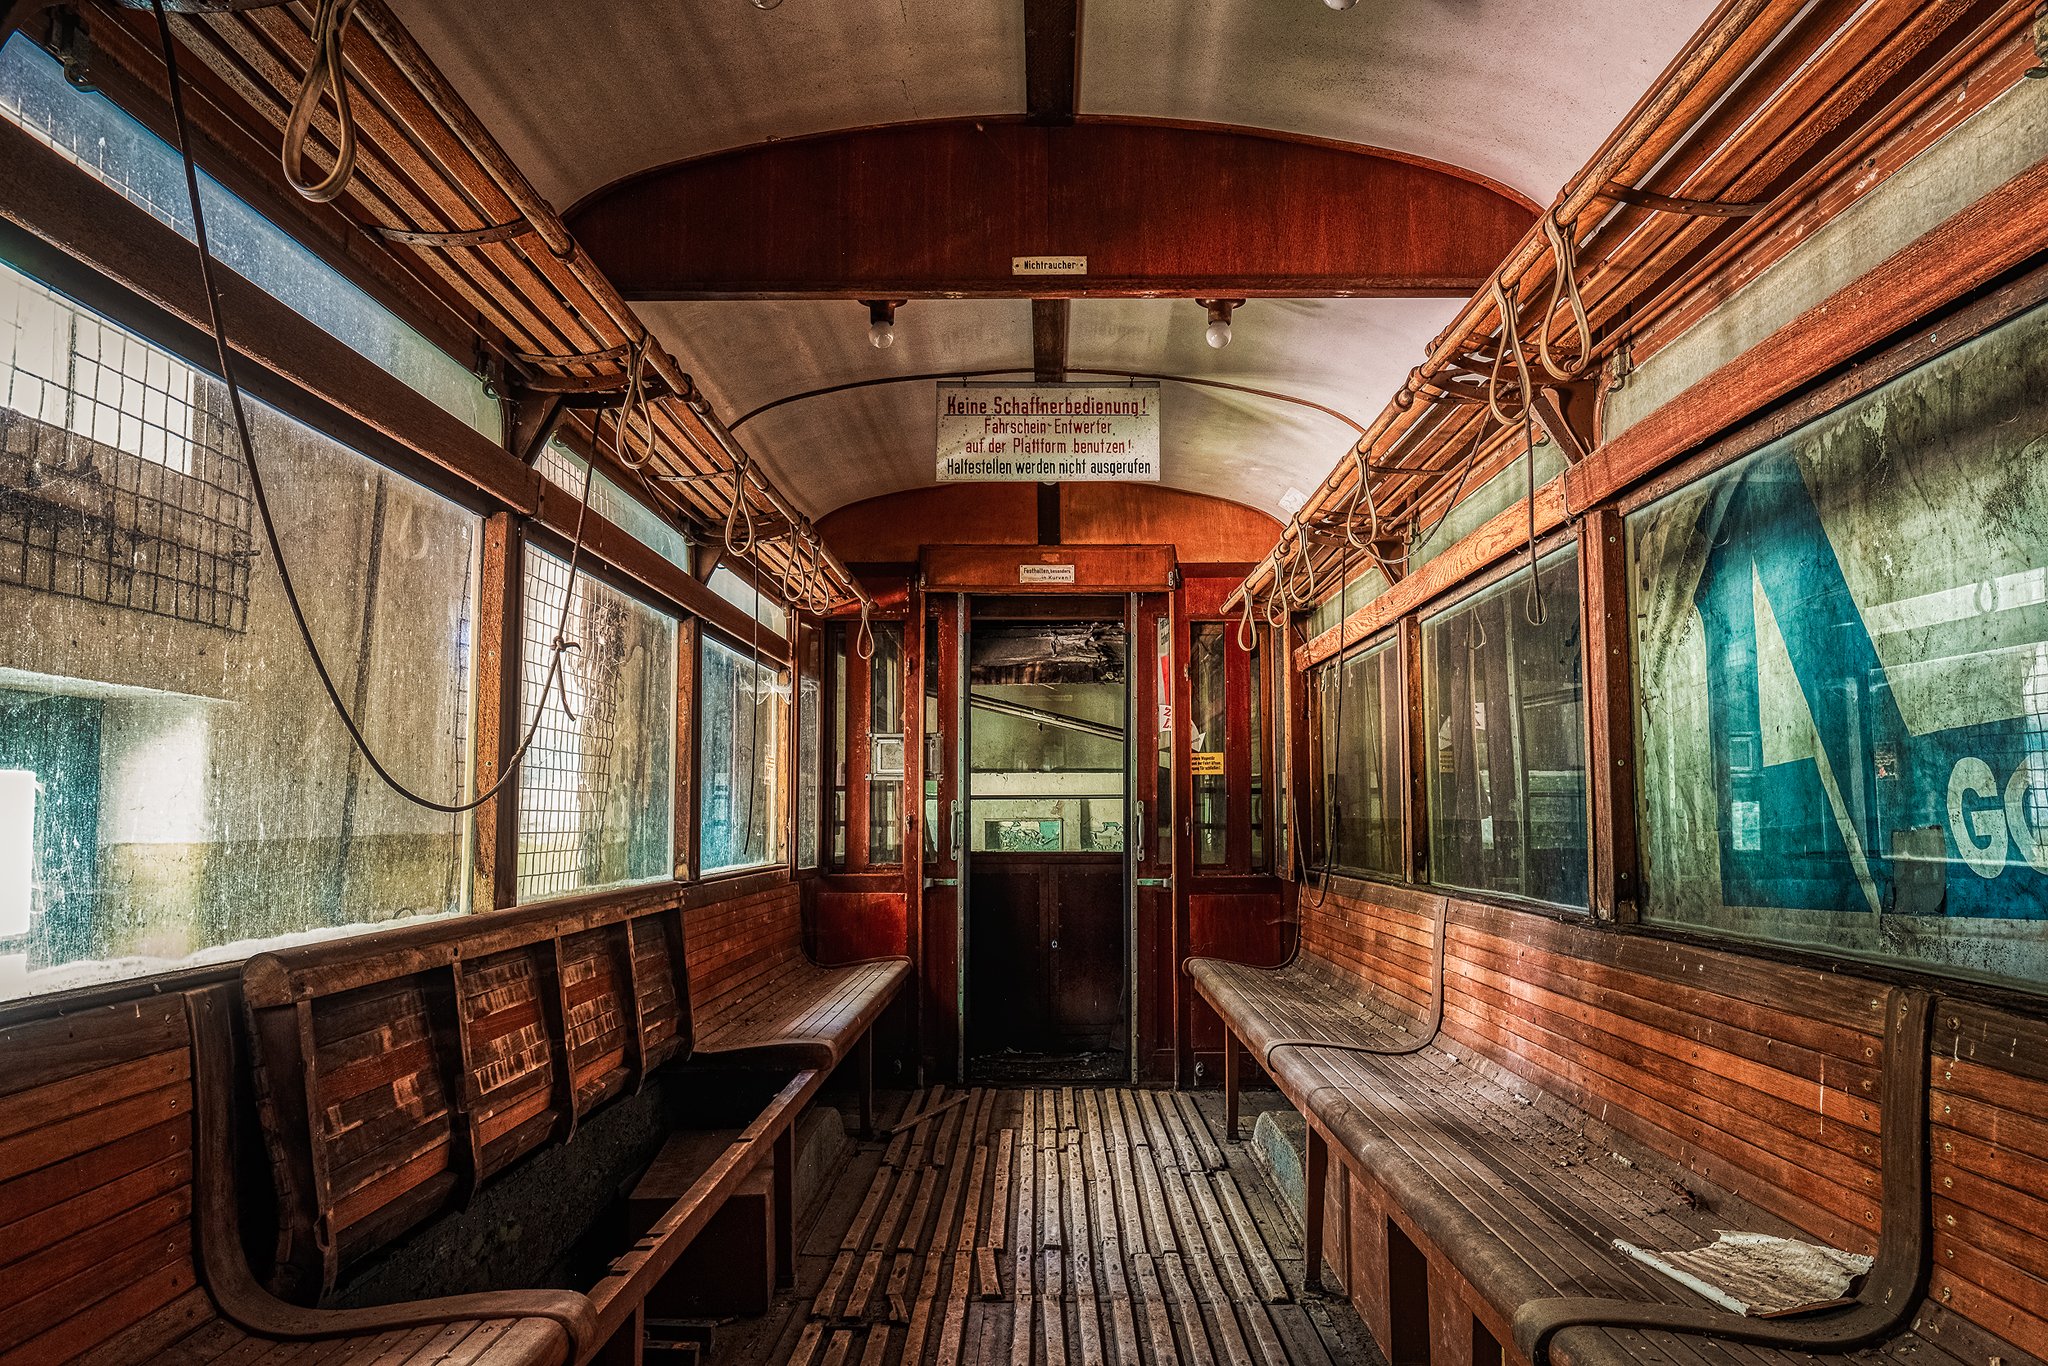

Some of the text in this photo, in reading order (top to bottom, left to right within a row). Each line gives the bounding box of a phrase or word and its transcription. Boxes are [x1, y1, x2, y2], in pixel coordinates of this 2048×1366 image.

[1024, 260, 1076, 269] Nichtraucher
[947, 396, 987, 414] Keine
[965, 437, 984, 453] auf
[988, 437, 1007, 453] der
[1013, 437, 1066, 453] Plattform
[947, 458, 1151, 477] Haltestellen werden nicht ausgerufen
